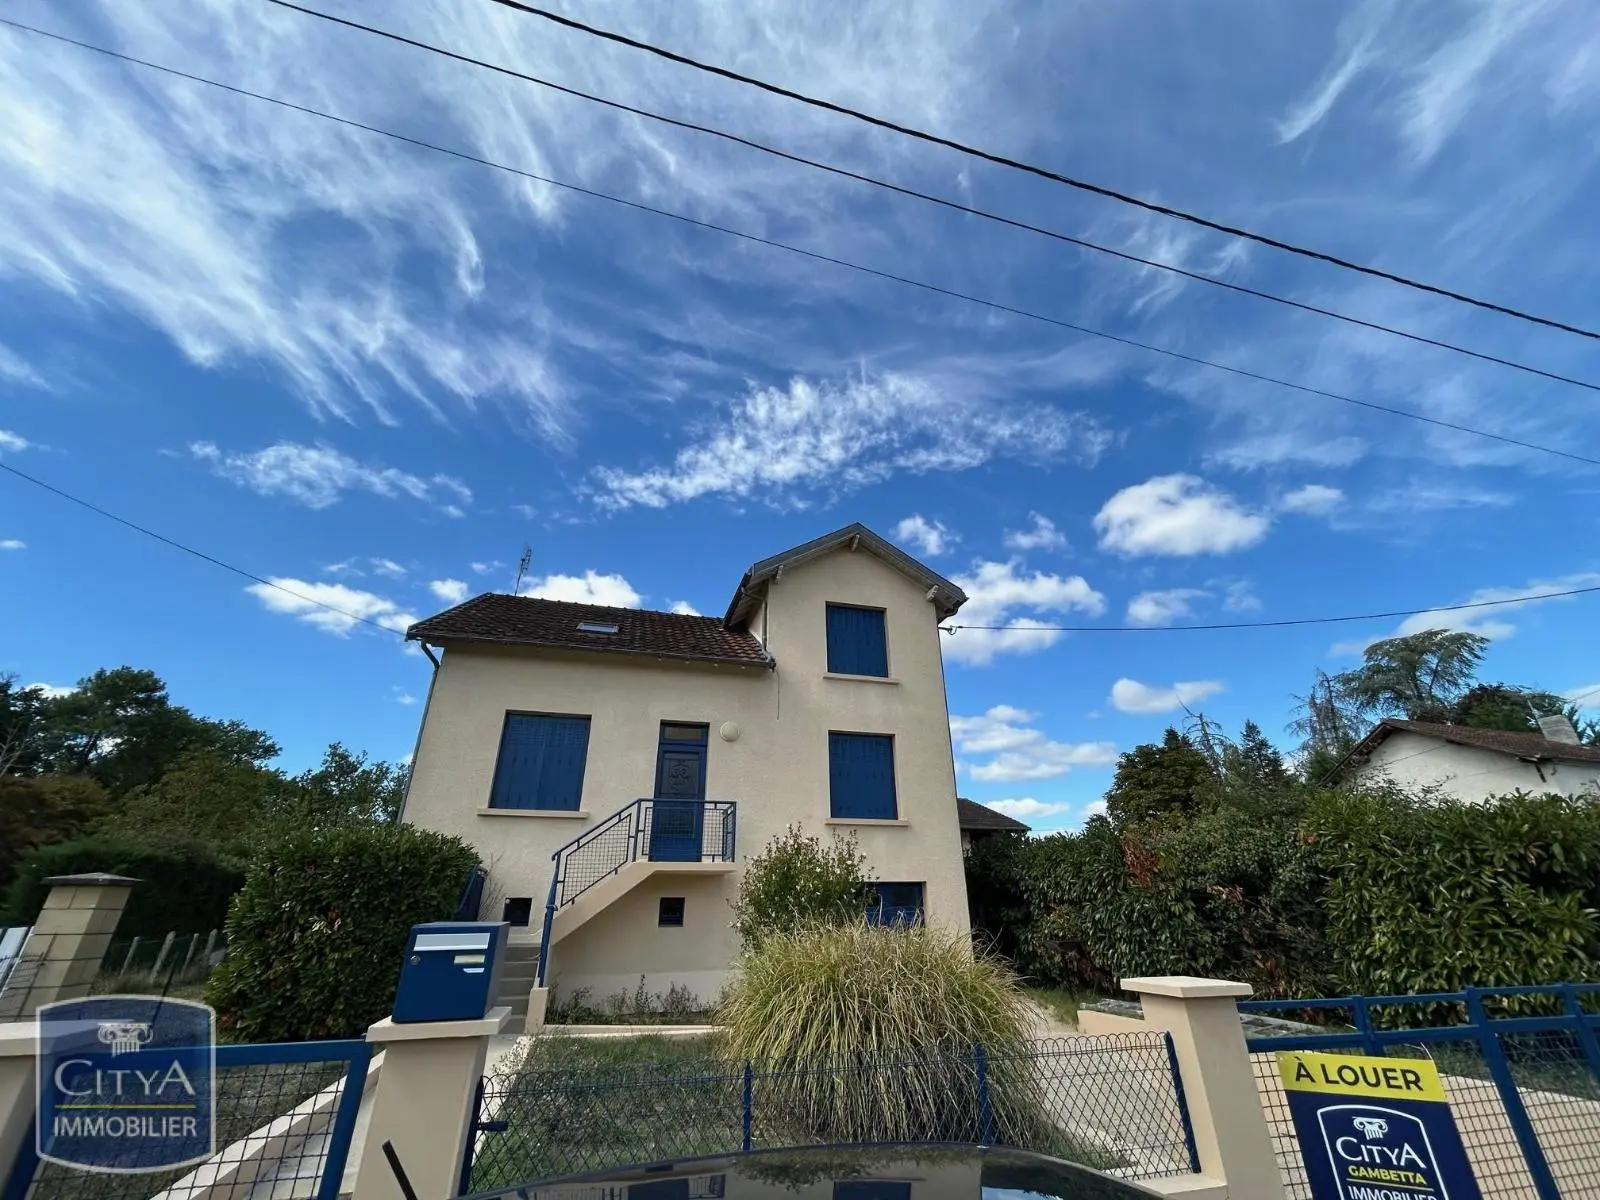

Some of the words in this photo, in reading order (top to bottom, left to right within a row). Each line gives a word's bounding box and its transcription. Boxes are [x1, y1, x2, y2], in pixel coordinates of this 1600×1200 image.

[1295, 1056, 1316, 1083] À
[1320, 1063, 1424, 1091] LOUER
[1336, 1136, 1427, 1169] CITYA
[1347, 1165, 1427, 1185] GAMBETTA
